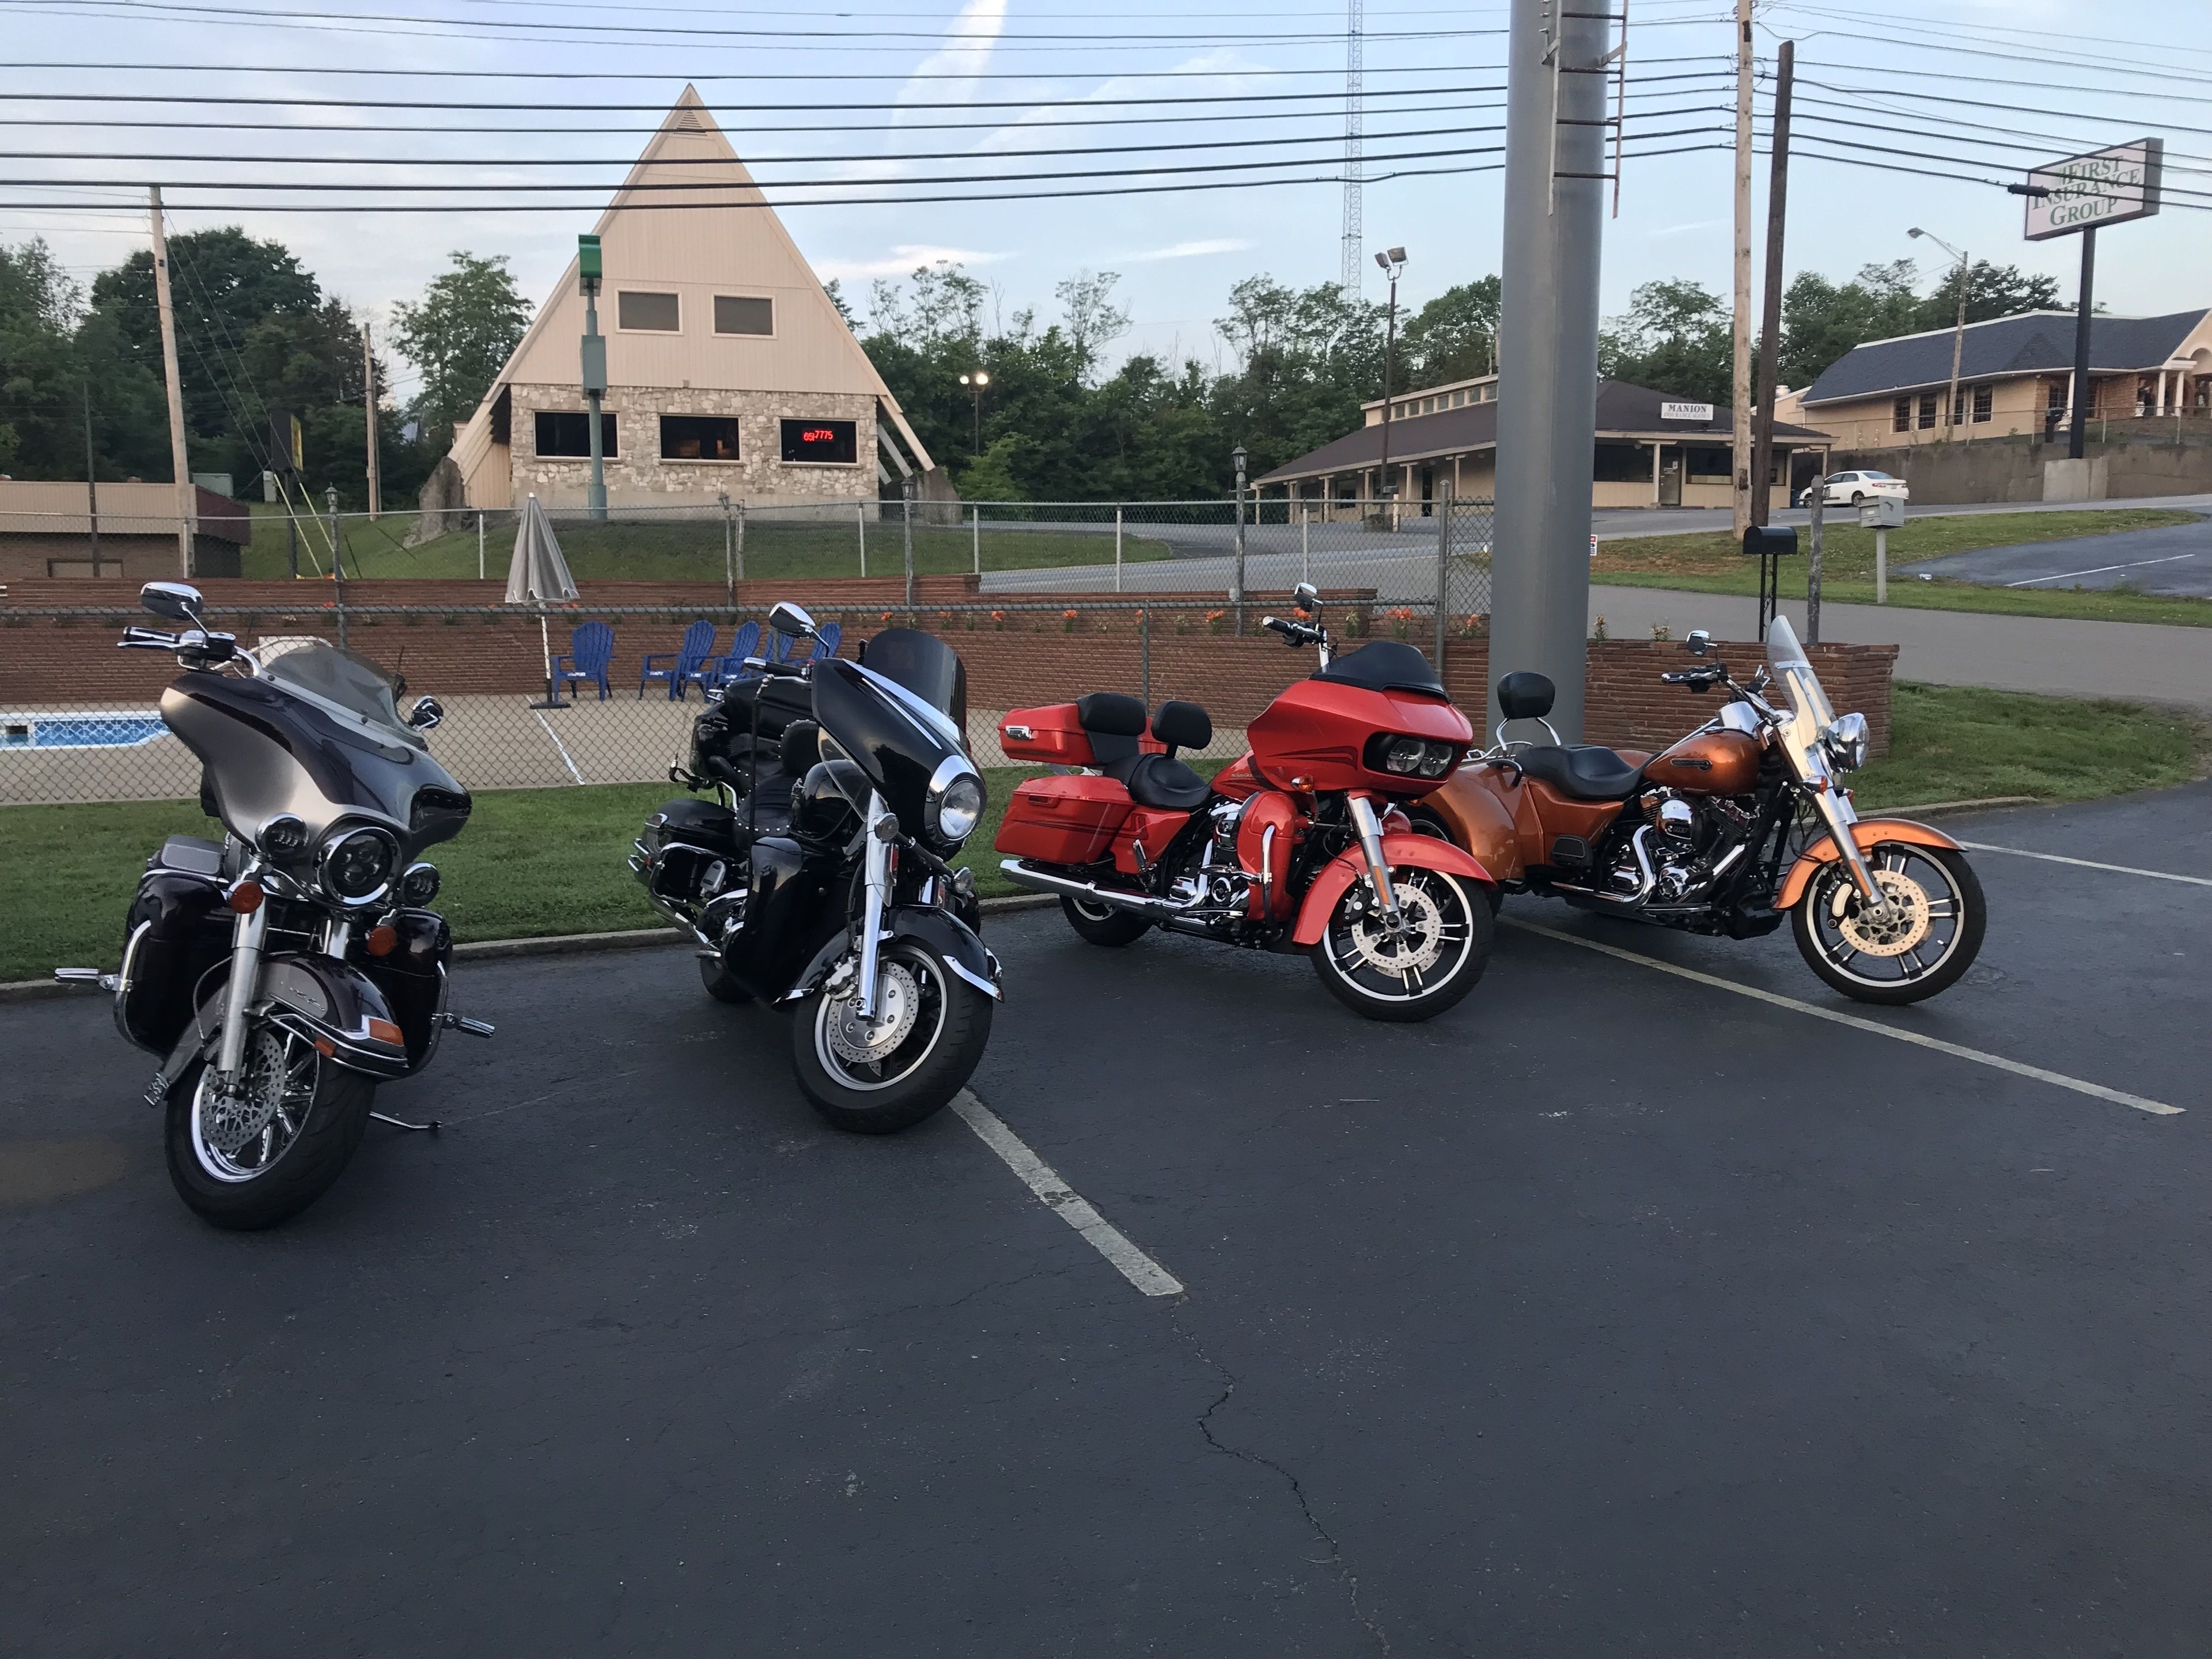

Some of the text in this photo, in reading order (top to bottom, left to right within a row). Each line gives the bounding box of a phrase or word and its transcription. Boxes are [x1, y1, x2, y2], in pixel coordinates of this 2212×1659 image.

[2066, 155, 2123, 184] FIRST
[2032, 168, 2140, 210] INSURANCE
[2050, 198, 2119, 226] GROUP
[1668, 404, 1707, 412] MANION
